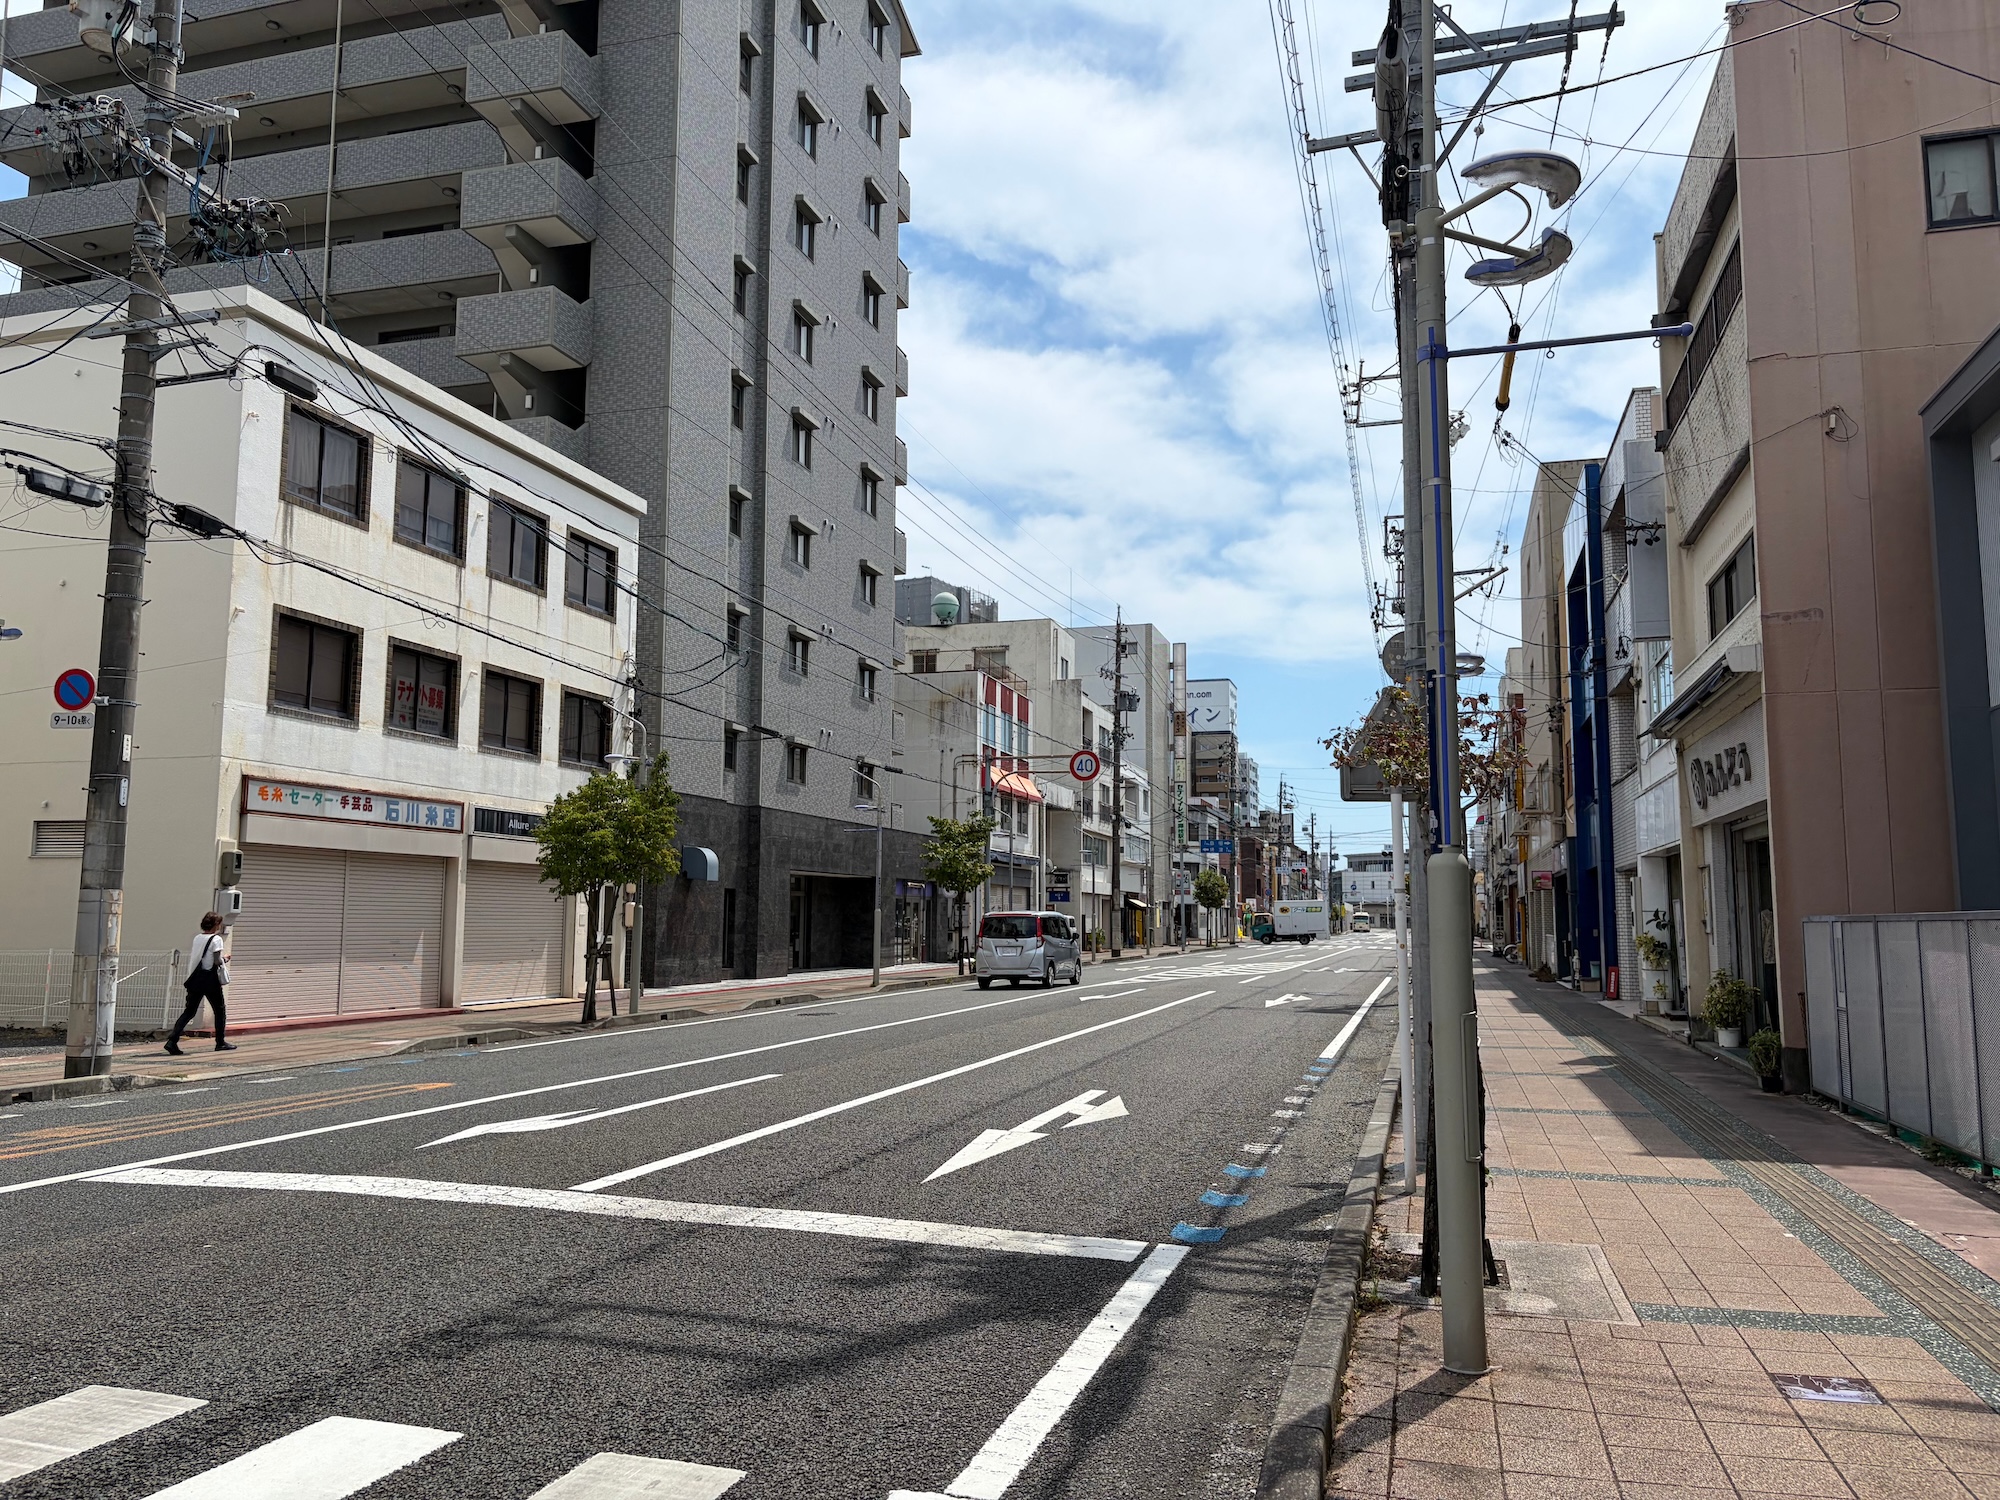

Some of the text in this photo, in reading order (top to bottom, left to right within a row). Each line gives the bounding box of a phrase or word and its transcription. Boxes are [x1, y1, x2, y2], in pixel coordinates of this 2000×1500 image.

[397, 680, 444, 710] テナト募集
[1077, 758, 1093, 773] 40
[385, 799, 455, 828] 石川糸店
[508, 819, 530, 831] Allure
